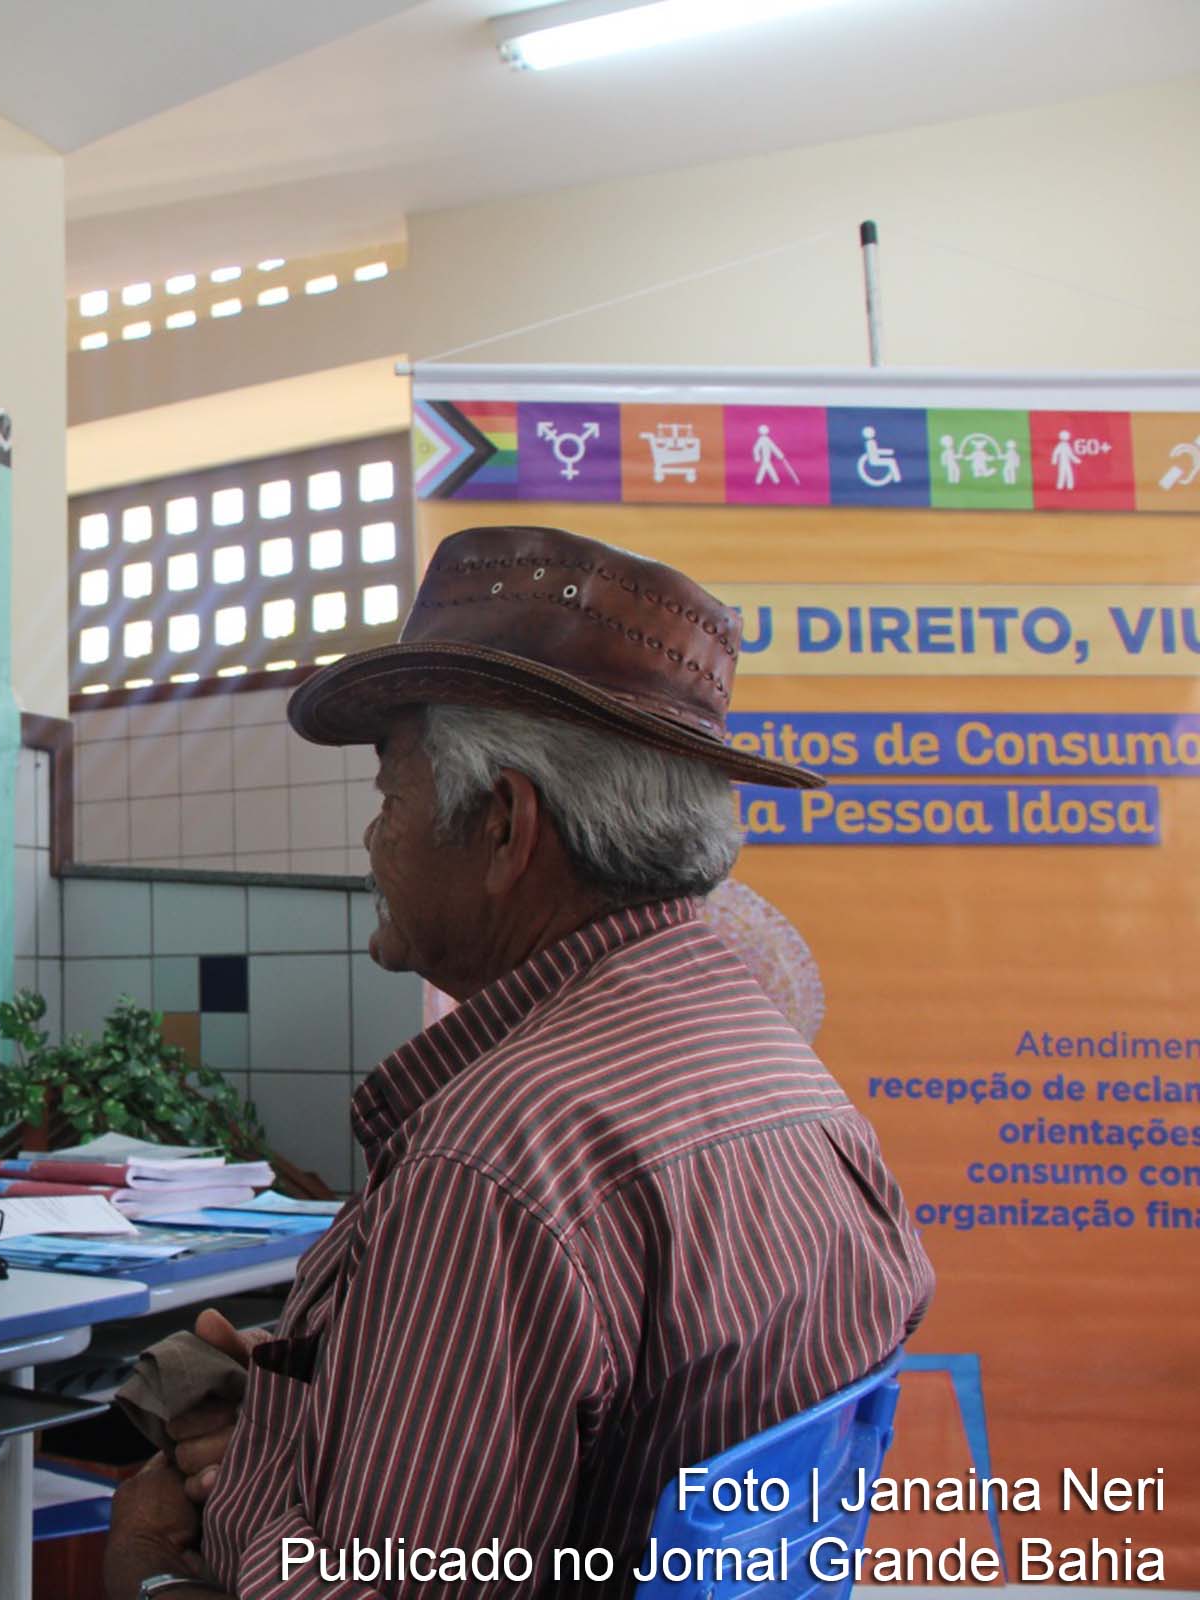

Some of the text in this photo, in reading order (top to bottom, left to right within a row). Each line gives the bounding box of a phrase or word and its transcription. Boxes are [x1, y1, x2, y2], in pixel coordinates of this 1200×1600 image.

[1074, 437, 1112, 456] 60+
[797, 606, 1090, 664] DIREITO,
[725, 720, 859, 766] eitos
[874, 722, 940, 766] de
[801, 790, 993, 834] Pessoa
[1007, 790, 1155, 834] Idosa
[1014, 1030, 1200, 1060] Atendimen
[869, 1072, 1032, 1104] recepção
[1043, 1074, 1086, 1102] de
[967, 1162, 1129, 1186] consumo
[915, 1199, 1136, 1232] organização
